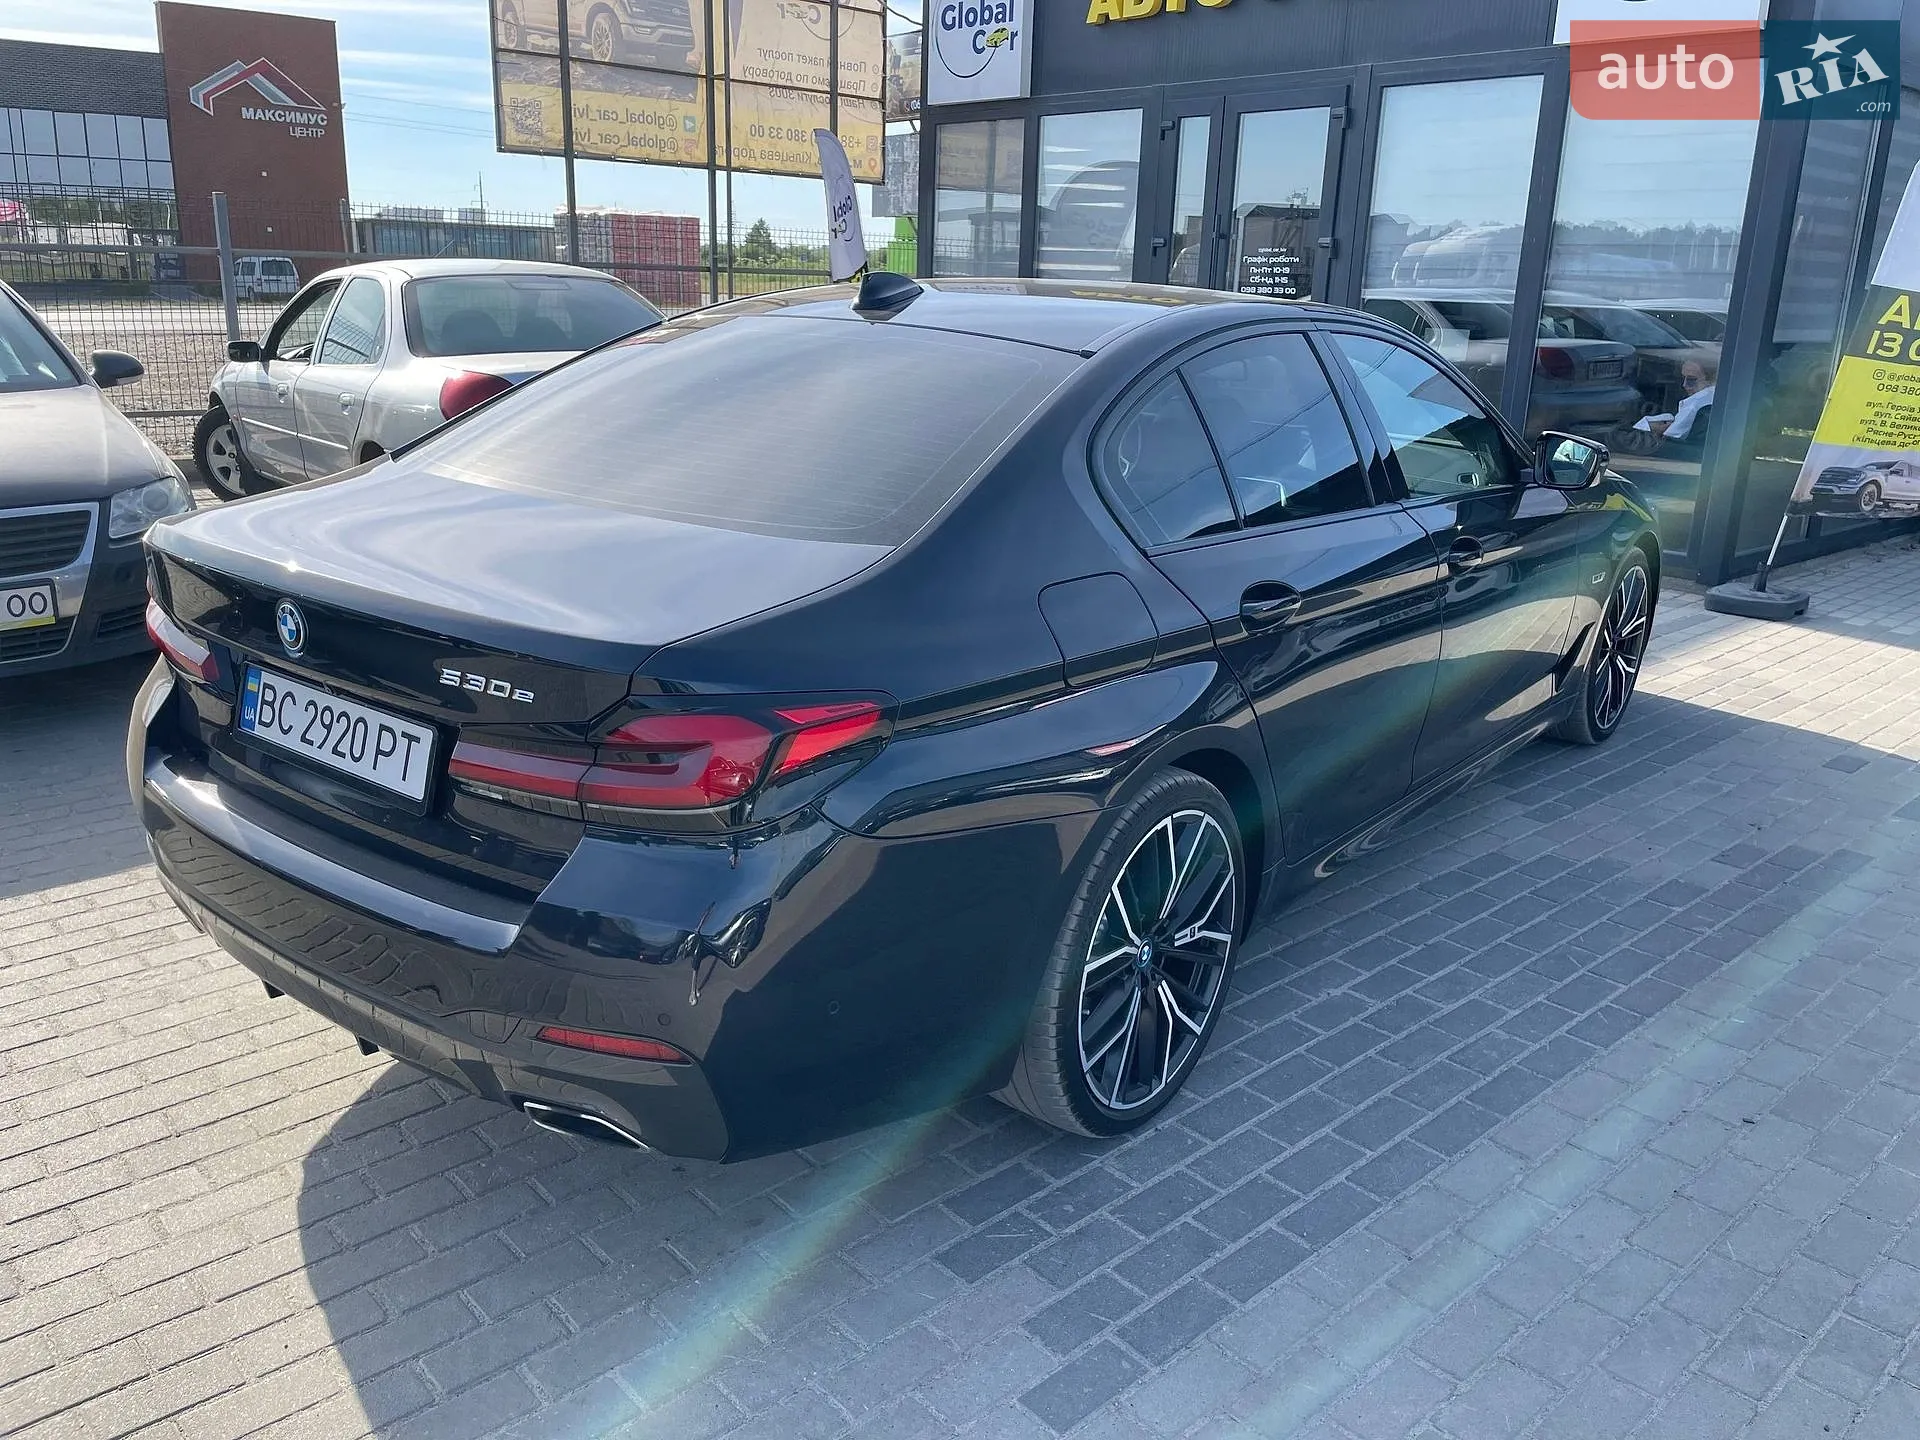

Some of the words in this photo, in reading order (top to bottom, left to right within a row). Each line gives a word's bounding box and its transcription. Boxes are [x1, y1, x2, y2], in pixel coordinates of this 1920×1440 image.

[941, 0, 1015, 31] Global
[972, 28, 1018, 55] Cr
[241, 106, 328, 126] МАКСИМУС
[289, 126, 325, 138] ЦЕНТР
[1242, 255, 1268, 264] Графік
[1269, 254, 1300, 264] роботи
[1285, 287, 1296, 295] 00
[1876, 383, 1899, 393] 098
[440, 667, 535, 704] 530e
[244, 705, 255, 721] UA
[258, 681, 297, 736] BC
[300, 699, 369, 763] 2920
[372, 722, 421, 783] PT
